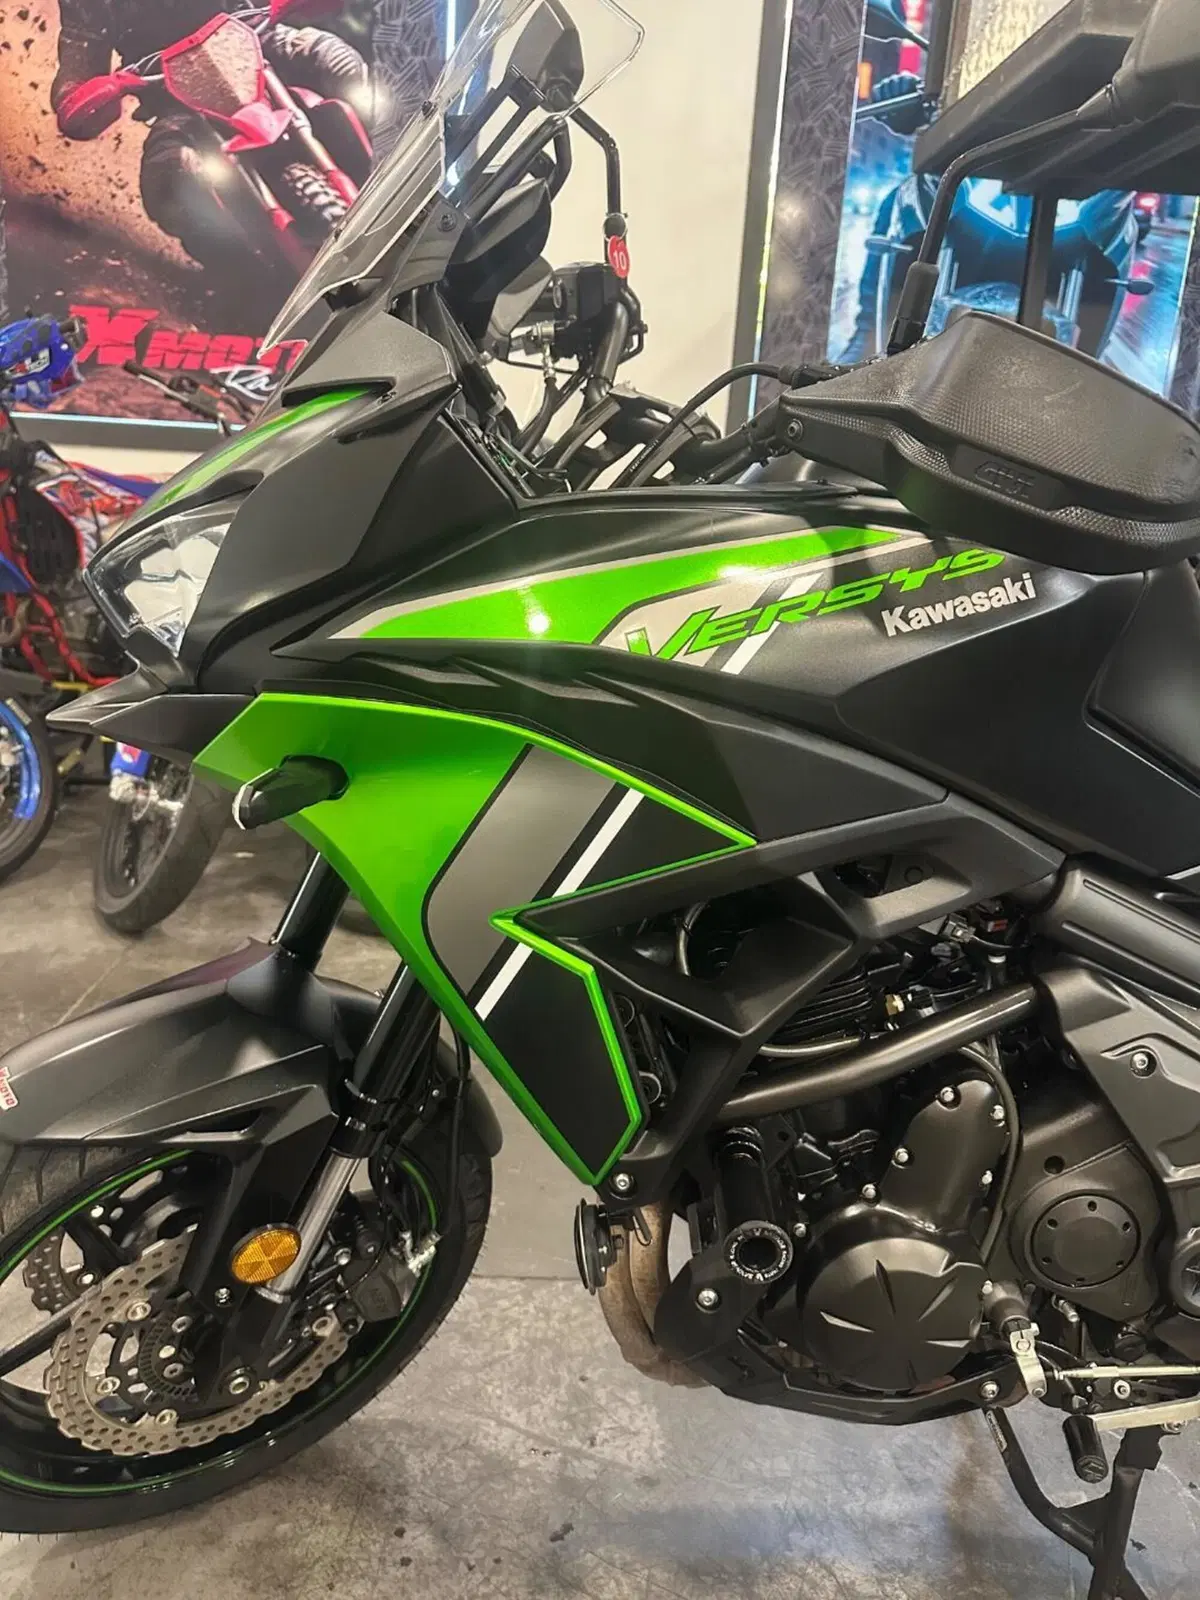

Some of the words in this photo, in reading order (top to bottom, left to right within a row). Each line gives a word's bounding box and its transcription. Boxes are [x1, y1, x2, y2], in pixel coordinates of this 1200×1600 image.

[612, 250, 628, 270] 10
[625, 548, 1006, 661] VERSYS
[881, 572, 1037, 637] Kawasaki
